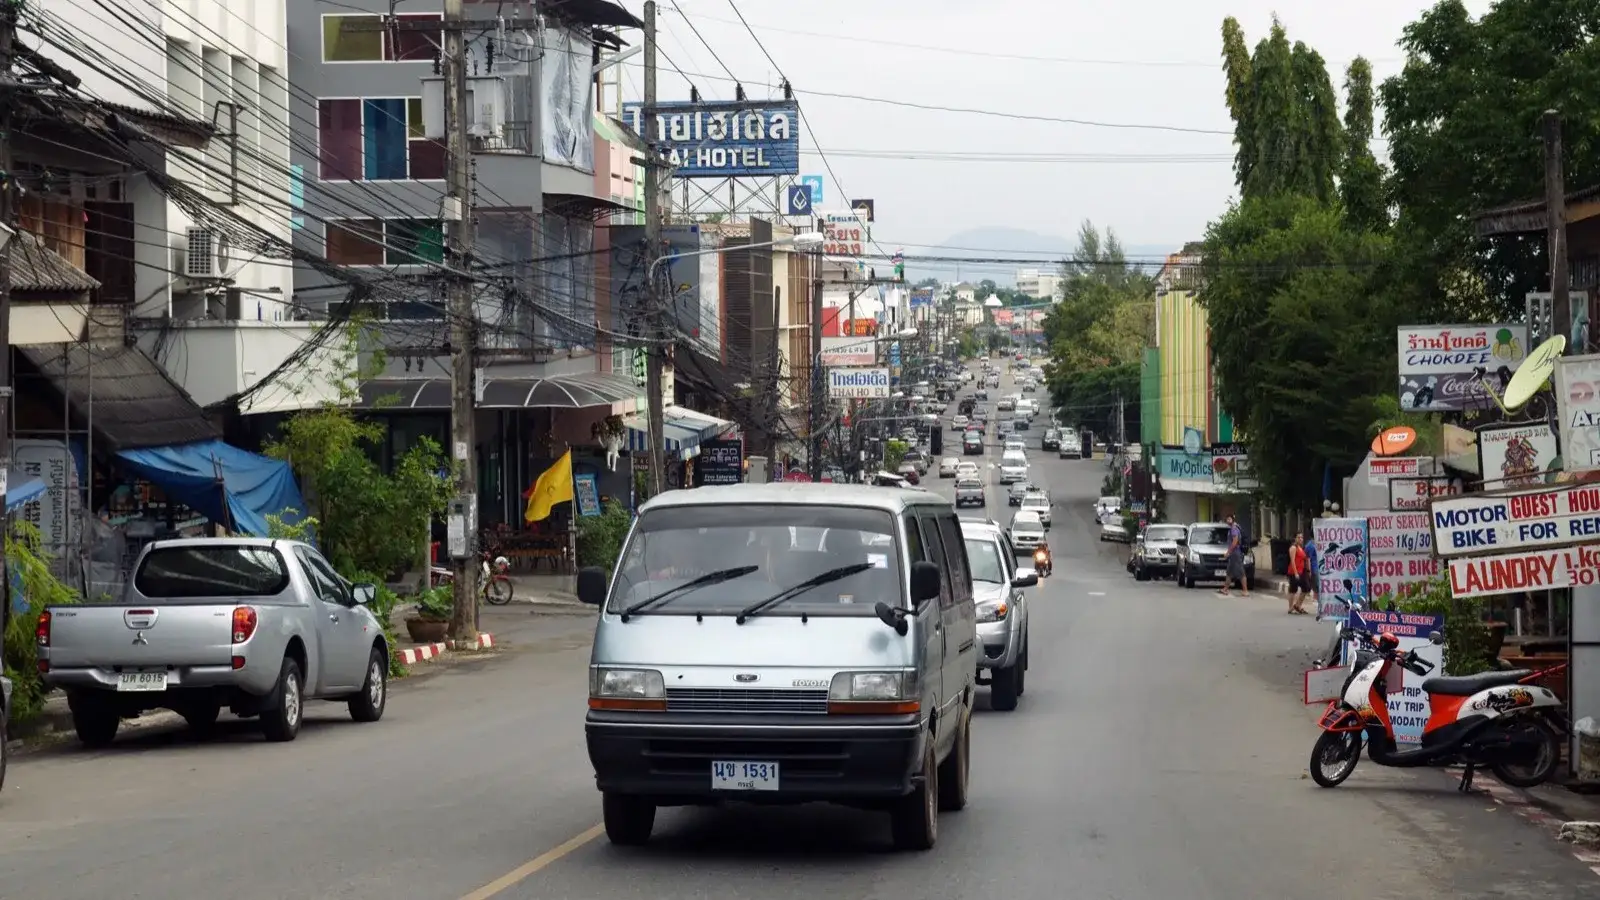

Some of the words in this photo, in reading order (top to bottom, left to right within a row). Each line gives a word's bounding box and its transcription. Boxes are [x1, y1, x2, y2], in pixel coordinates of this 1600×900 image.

[697, 147, 771, 168] HOTEL
[1408, 329, 1488, 352] ร้านโชคดี
[1407, 352, 1492, 366] CHOKDEE
[831, 387, 854, 397] THAI
[1170, 458, 1212, 477] MyOptics
[1510, 493, 1558, 520] GUEST
[1567, 488, 1600, 513] HOU
[1368, 515, 1395, 530] NDRY
[1396, 514, 1430, 530] SERVIC
[1435, 503, 1508, 529] MOTOR
[1317, 527, 1364, 542] MOTOR
[1452, 528, 1497, 549] BIKE
[1519, 521, 1559, 542] FOR
[1371, 536, 1394, 549] RESS
[1324, 553, 1357, 571] FOR
[1369, 561, 1404, 578] OTOR
[1408, 559, 1439, 576] BIKE
[1449, 552, 1559, 596] LAUNDRY
[1320, 579, 1365, 594] RET
[1359, 611, 1387, 622] TOUR
[1389, 613, 1399, 623] &
[1402, 614, 1436, 626] TICKET
[1376, 623, 1417, 636] SERVICE
[139, 673, 163, 683] 6015
[792, 679, 829, 687] TOYOTA
[1402, 687, 1422, 698] TRIP
[1404, 701, 1425, 713] TRIP
[1389, 715, 1429, 728] MODATIO
[742, 763, 775, 779] 1531
